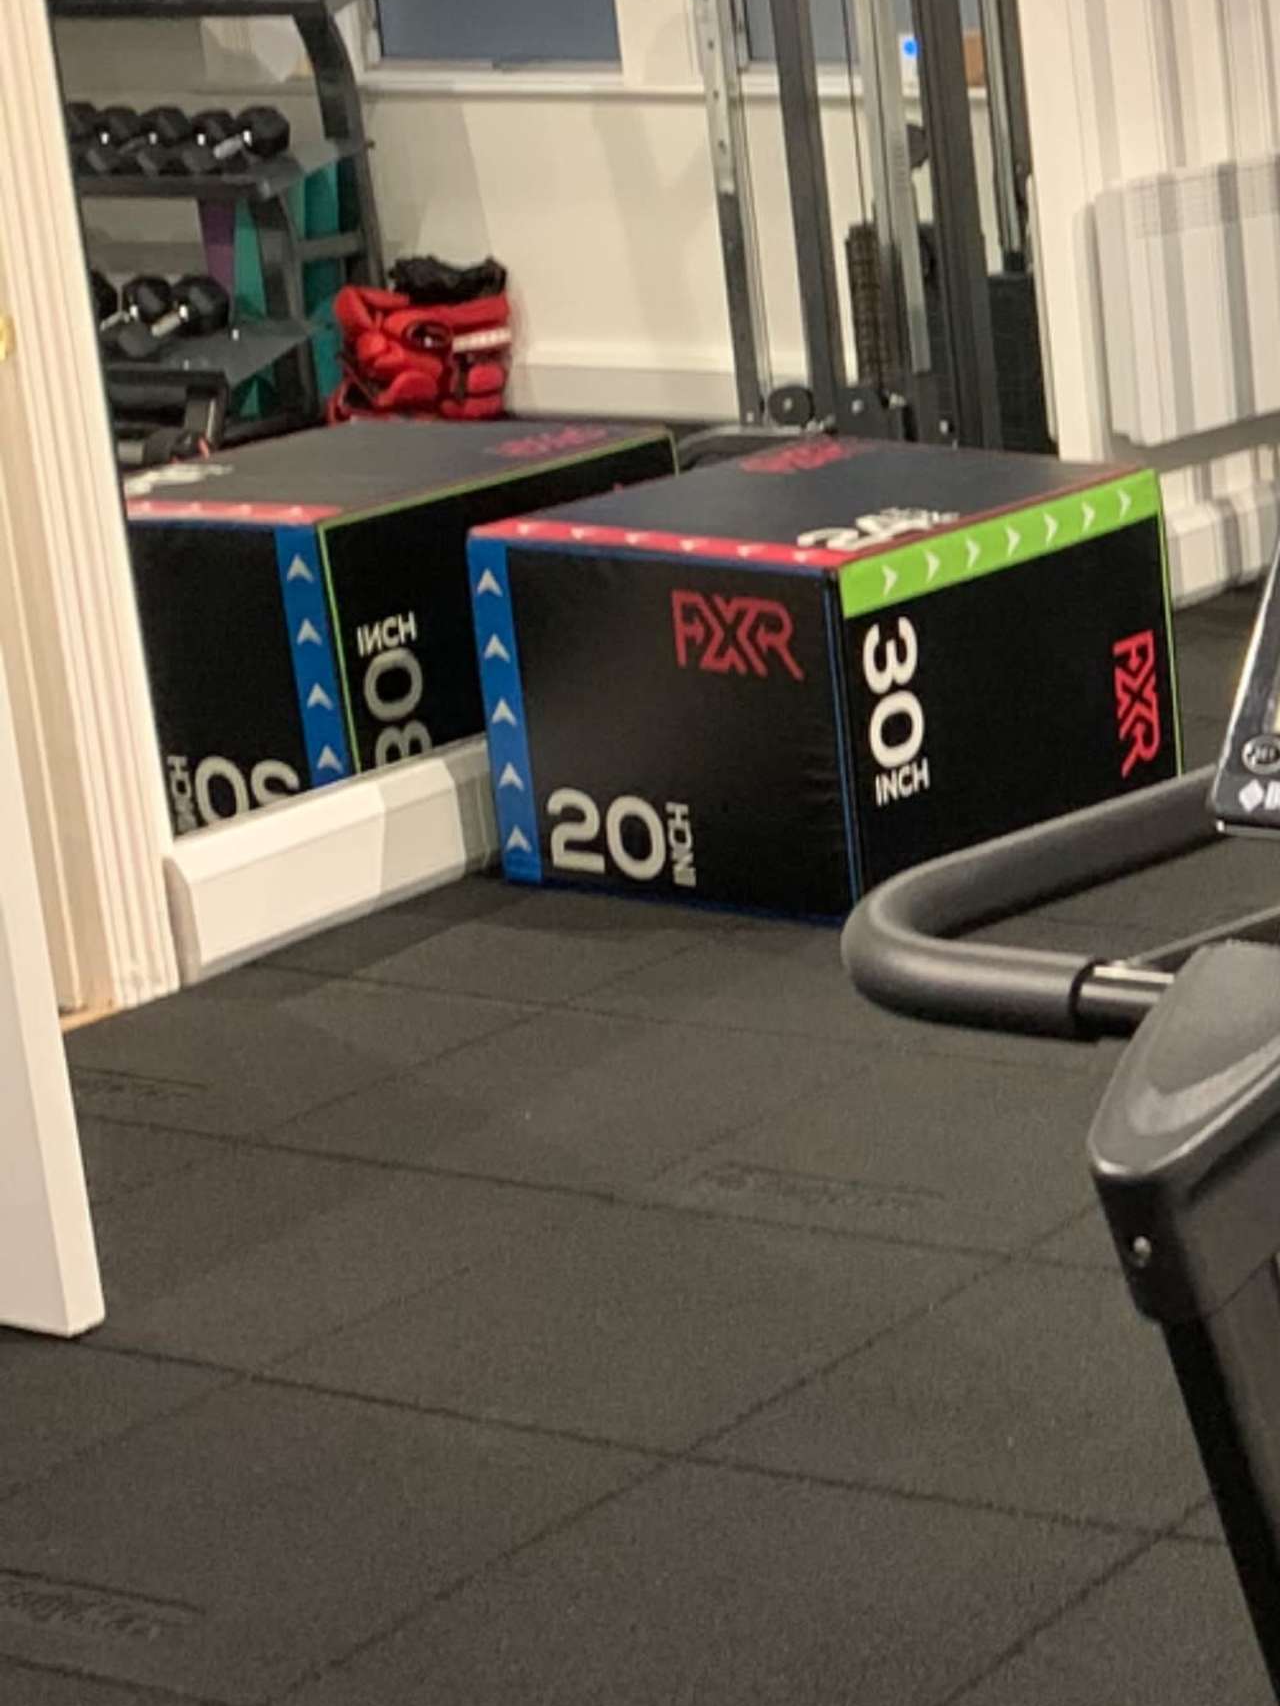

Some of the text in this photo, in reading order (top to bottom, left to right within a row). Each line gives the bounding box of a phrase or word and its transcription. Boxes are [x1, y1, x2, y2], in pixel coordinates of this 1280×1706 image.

[862, 616, 930, 807] 30 INCH
[1113, 629, 1162, 779] FXR
[546, 788, 697, 888] 20 INCH
